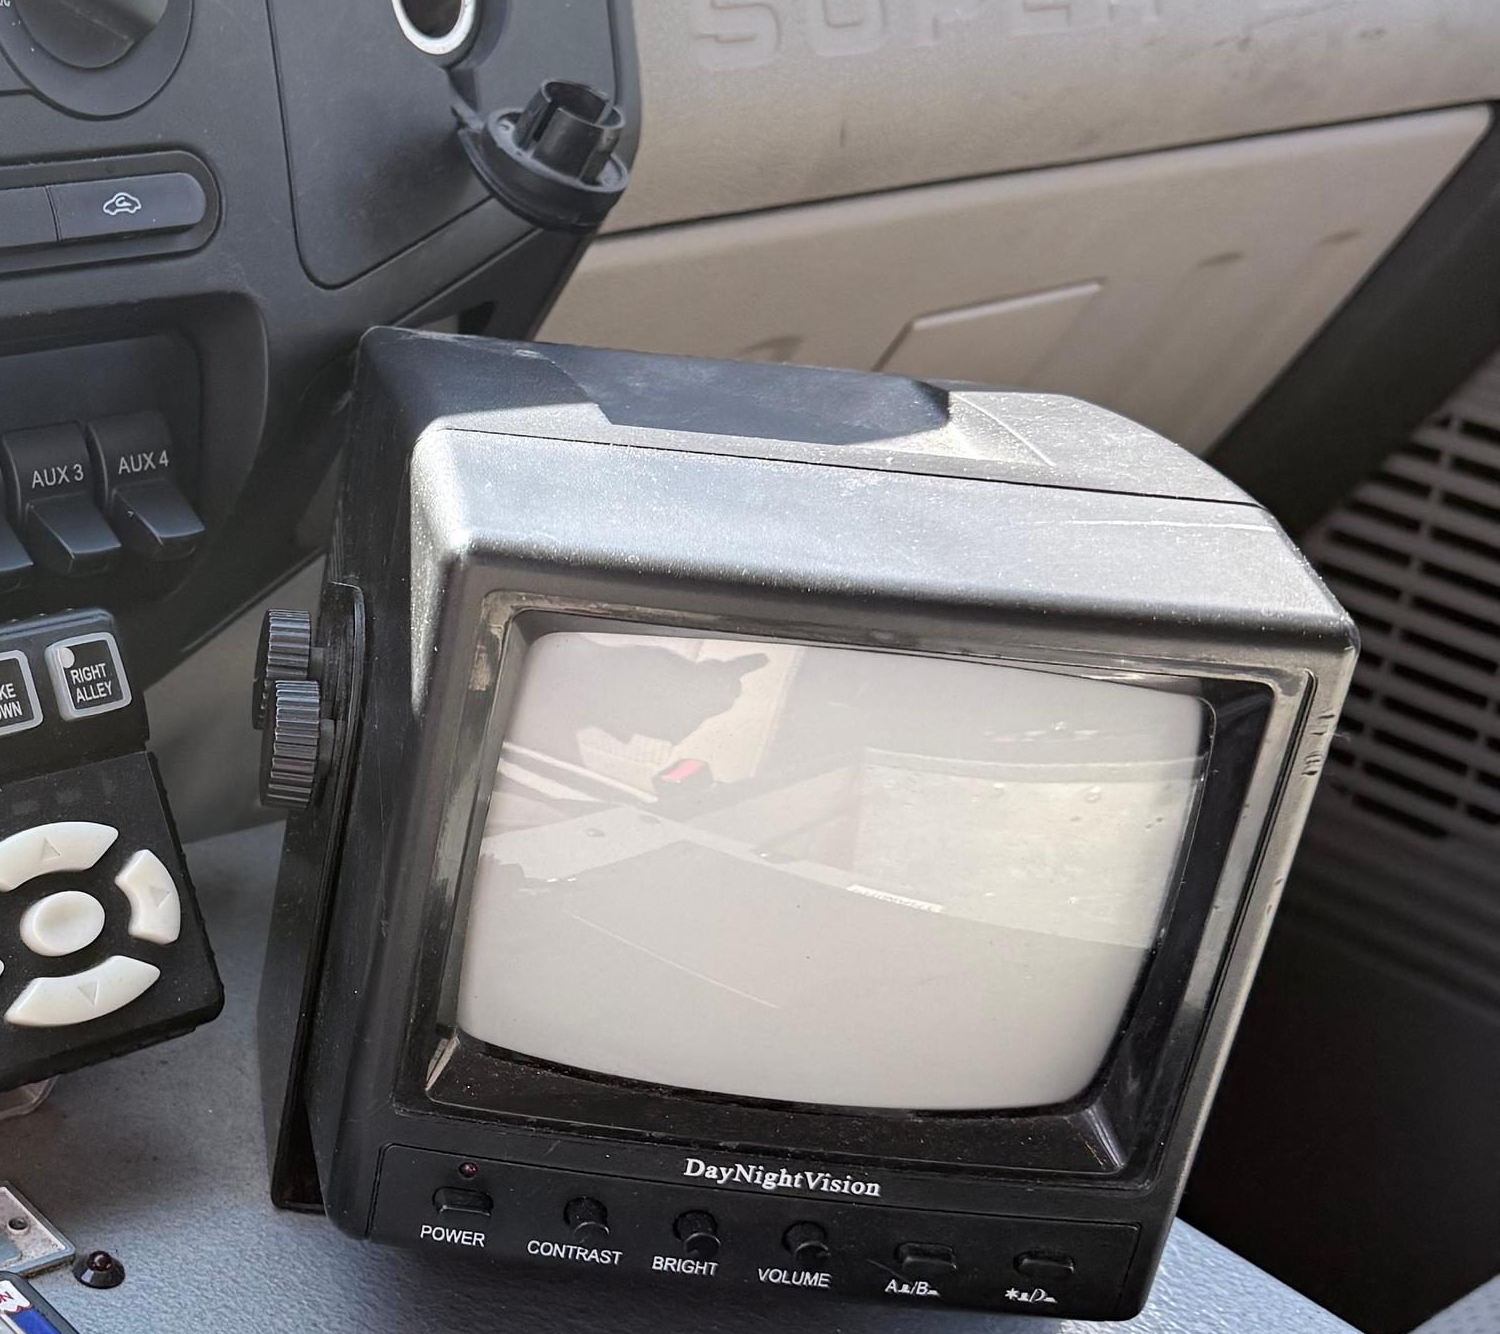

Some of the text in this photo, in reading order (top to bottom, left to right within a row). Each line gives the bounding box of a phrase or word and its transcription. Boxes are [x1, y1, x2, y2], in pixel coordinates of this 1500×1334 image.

[118, 450, 169, 475] AUX 4
[31, 463, 84, 488] AUX 3
[69, 662, 107, 686] RIGHT
[75, 679, 114, 704] ALLEY
[683, 1158, 881, 1197] DayNightVision
[420, 1225, 485, 1247] POWER
[527, 1240, 623, 1265] CONTRAST
[652, 1255, 718, 1276] BRIGHT
[757, 1267, 831, 1289] VOLUME
